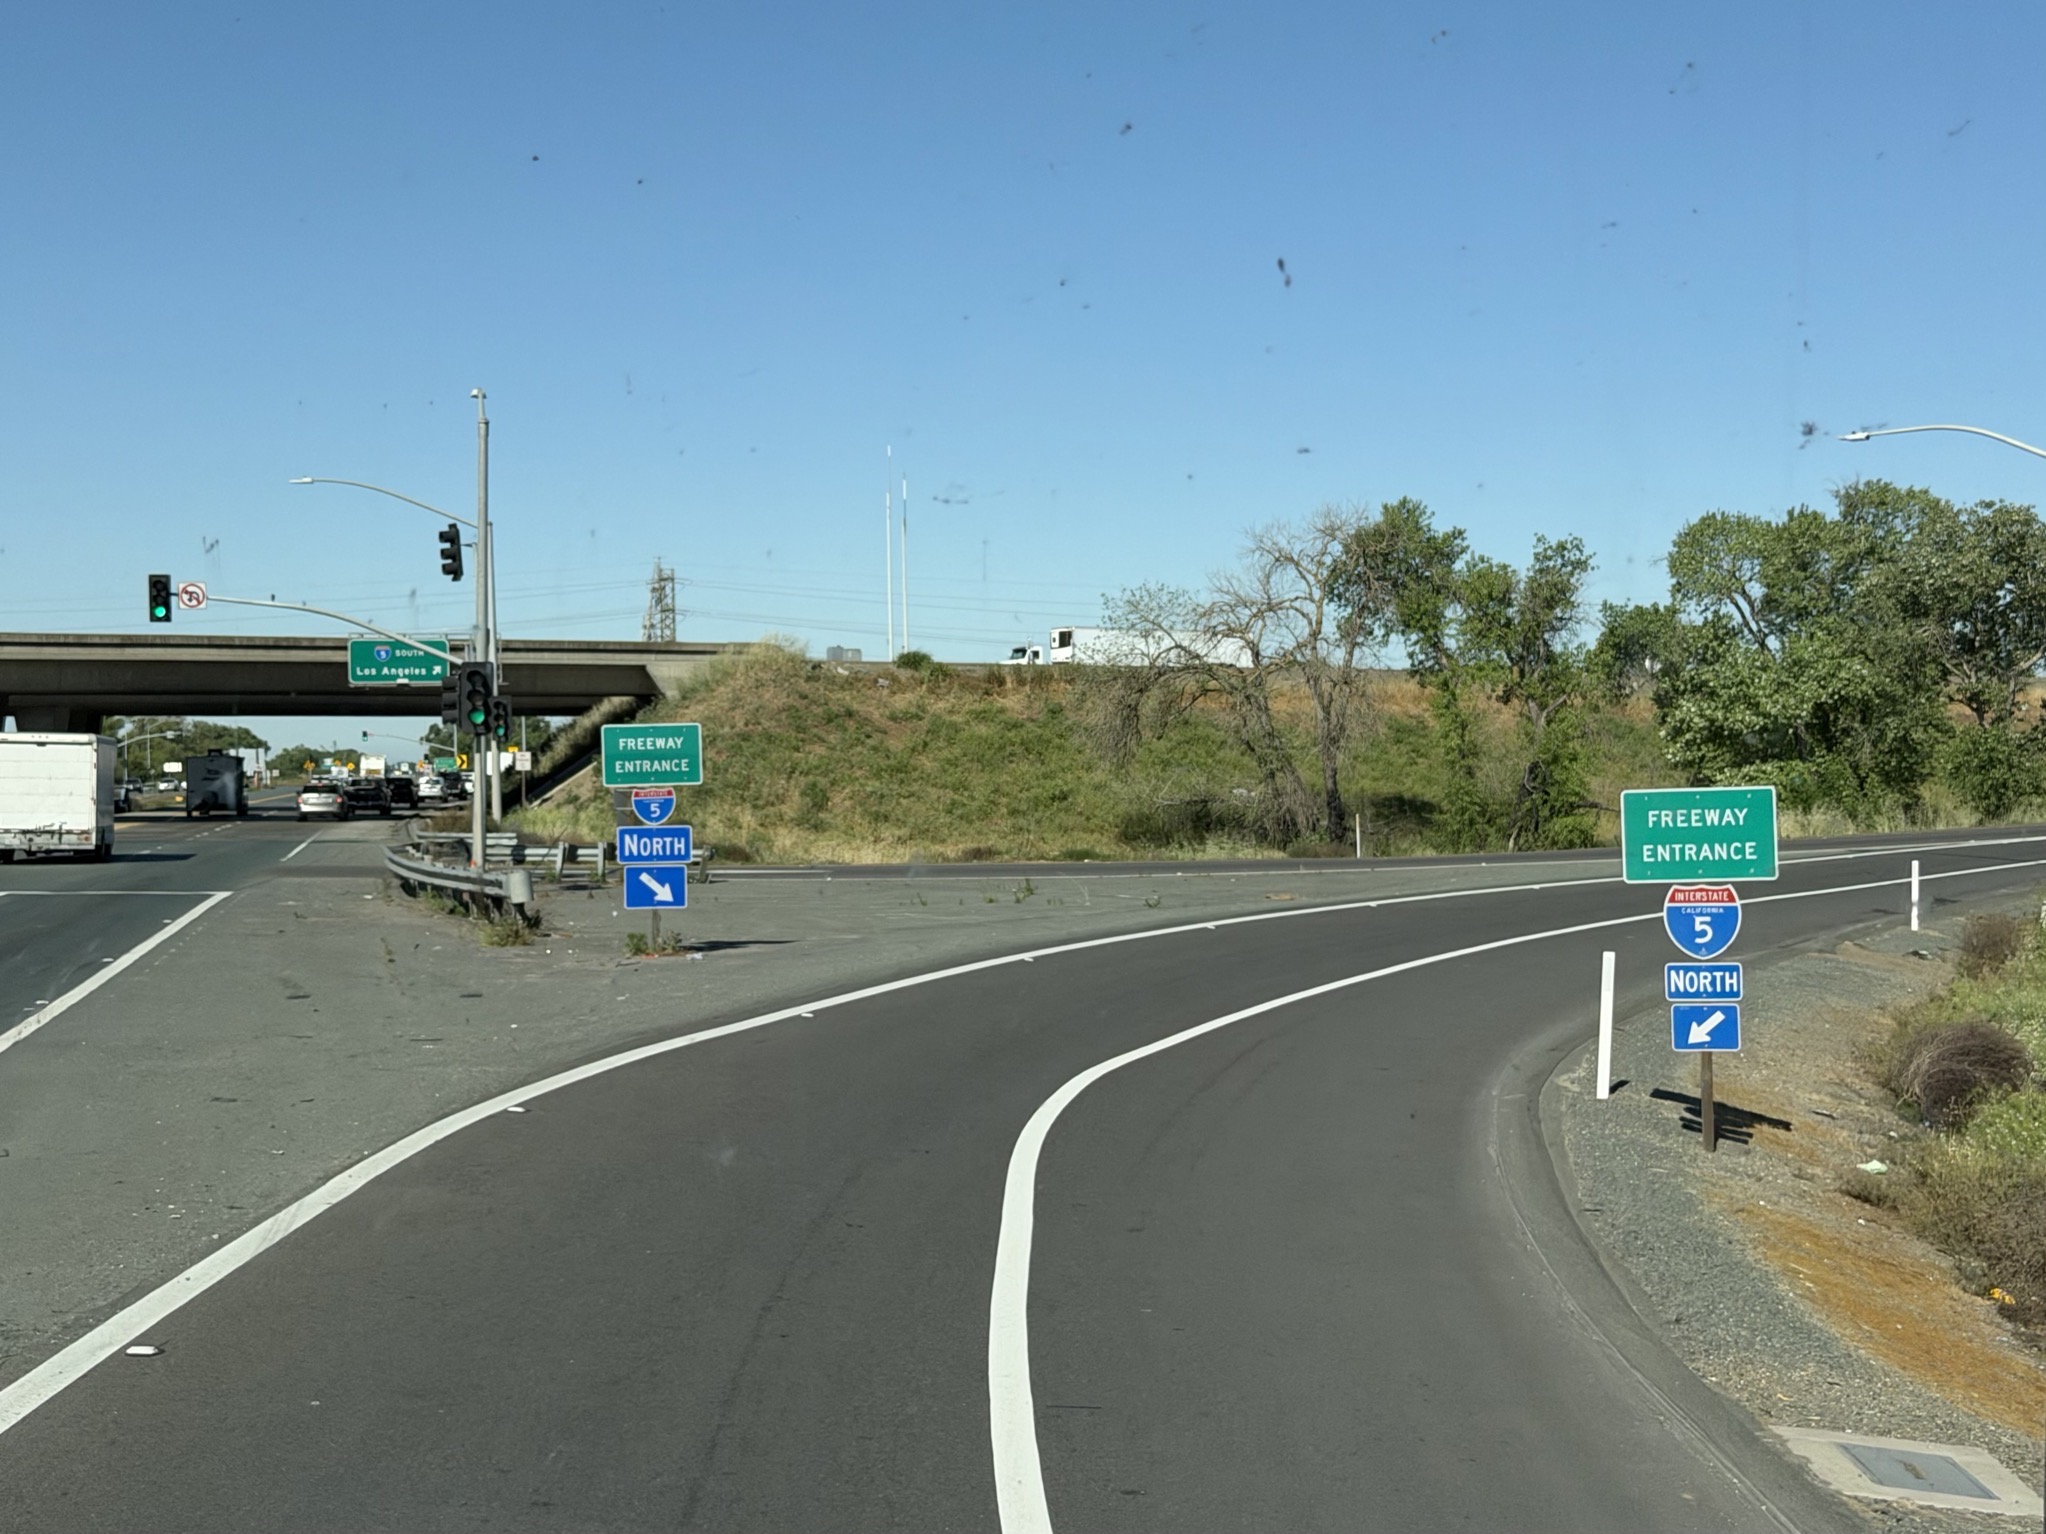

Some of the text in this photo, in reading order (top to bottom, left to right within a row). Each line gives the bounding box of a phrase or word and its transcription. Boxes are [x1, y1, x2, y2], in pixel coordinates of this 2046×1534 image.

[380, 649, 424, 659] 5 SOUTH
[356, 666, 427, 677] Los Angeles
[618, 736, 684, 751] FREEWAY
[615, 758, 690, 773] ENTRANCE
[650, 803, 660, 818] 5
[1648, 808, 1748, 827] FREEWAY
[624, 834, 685, 857] NORTH
[1643, 842, 1757, 862] ENTRANCE
[1674, 891, 1729, 901] INTERSTATE
[1694, 916, 1713, 944] 5
[1670, 969, 1738, 993] NORTH
